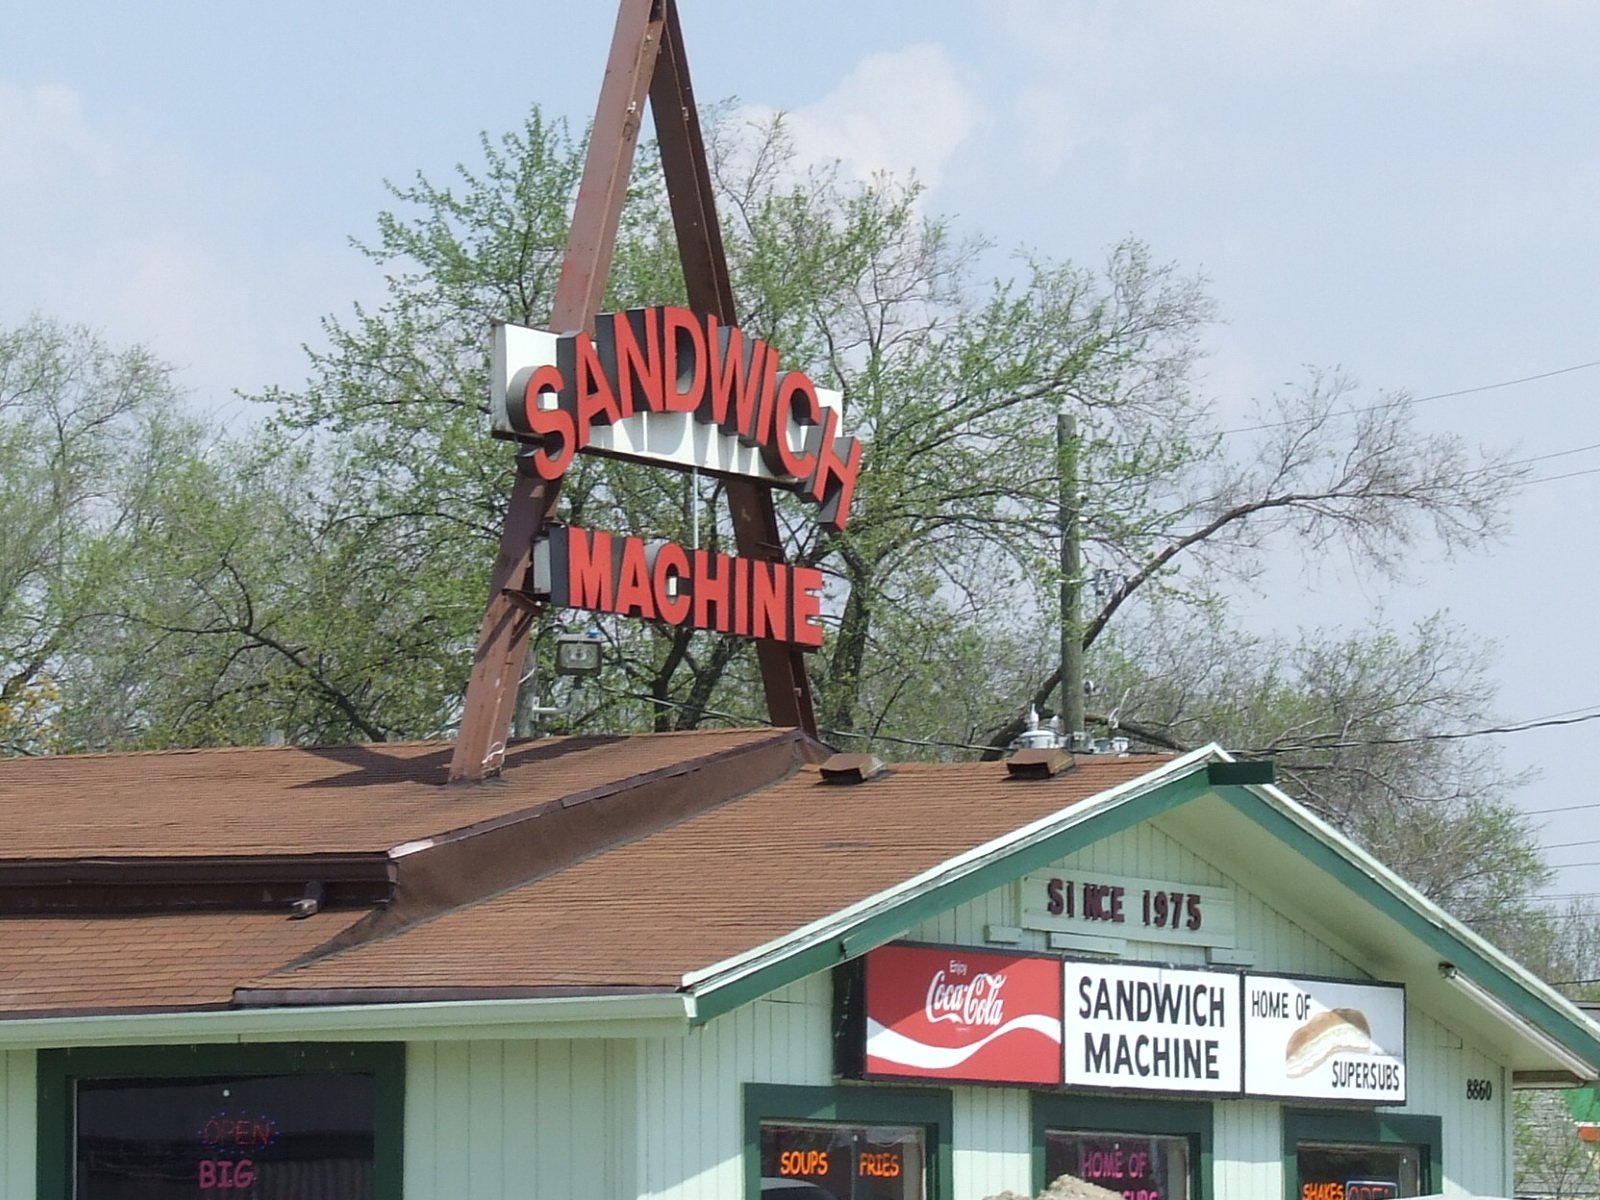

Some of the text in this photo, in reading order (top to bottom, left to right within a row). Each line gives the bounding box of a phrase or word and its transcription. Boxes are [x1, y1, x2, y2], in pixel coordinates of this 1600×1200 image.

[525, 306, 862, 531] SANDWICH
[568, 527, 823, 646] MACHINE
[1047, 878, 1202, 931] SINCE 1975
[926, 970, 1007, 1026] Coca-Cola
[1078, 976, 1225, 1028] SANDWICH
[1251, 989, 1312, 1020] HOME OF
[1084, 1032, 1220, 1079] MACHINE
[1332, 1061, 1400, 1091] SUPERSUBS
[1466, 1079, 1492, 1101] 8860
[203, 1121, 270, 1146] OPEN
[199, 1160, 256, 1189] BIG
[780, 1151, 829, 1175] SOUPS
[859, 1153, 900, 1177] FRIES
[1081, 1151, 1148, 1178] HOME OF
